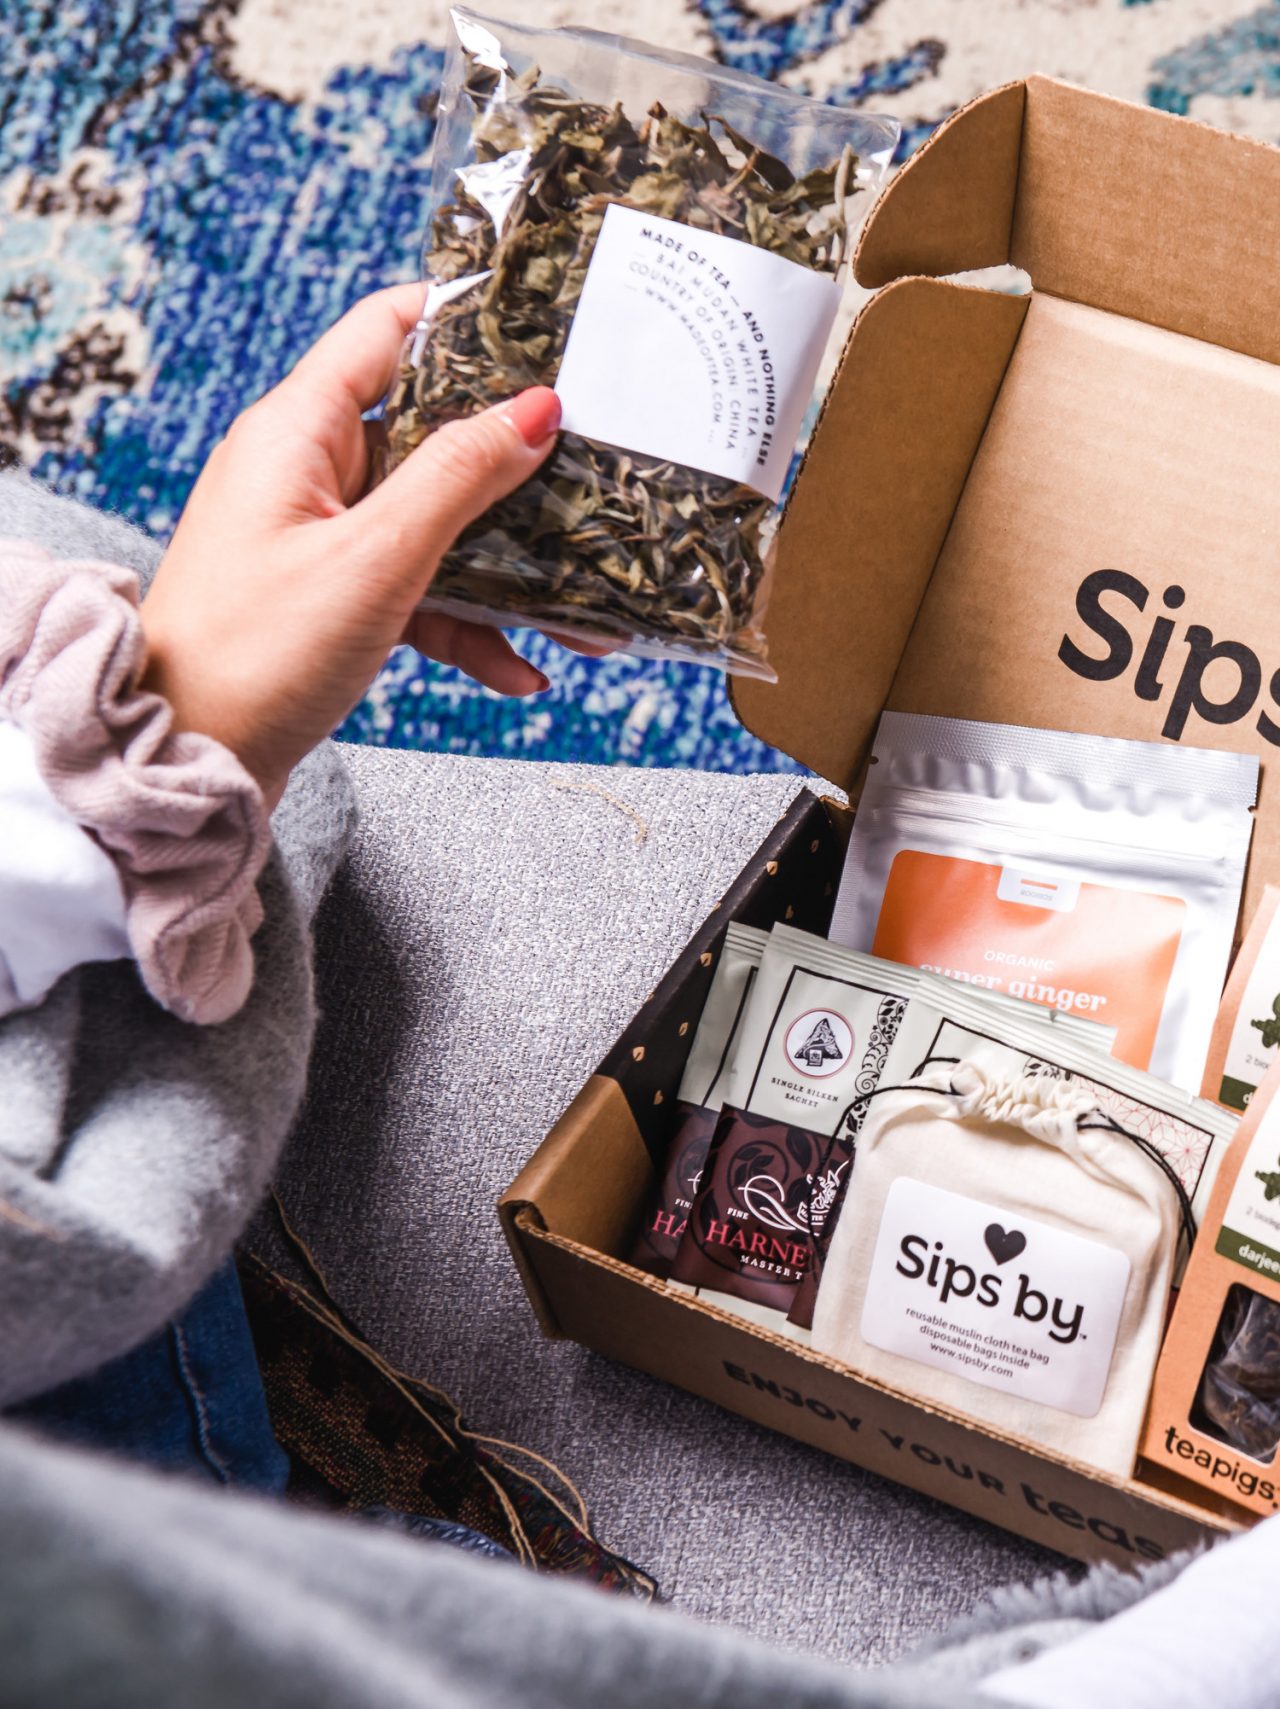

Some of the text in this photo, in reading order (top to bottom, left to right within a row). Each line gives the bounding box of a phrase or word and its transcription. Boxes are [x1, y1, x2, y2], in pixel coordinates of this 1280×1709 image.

[641, 228, 683, 252] MADE
[687, 250, 706, 266] OF
[709, 266, 730, 290] TEA
[692, 276, 738, 331] MUDAN
[742, 311, 764, 342] AND
[629, 261, 694, 302] COUNTRY
[696, 306, 714, 322] OF
[726, 399, 742, 449] CHINA
[736, 338, 760, 395] WHITE
[758, 349, 776, 425] NOTHING
[747, 407, 759, 436] TEA
[756, 432, 773, 466] ELSE
[984, 950, 1056, 972] ORGANIC
[1008, 976, 1107, 1012] ginger
[771, 1077, 839, 1102] SINGLE SILKEN
[785, 1093, 819, 1108] SACHET
[653, 1210, 688, 1239] HA
[727, 1207, 750, 1220] FINE
[705, 1220, 813, 1268] HARNE
[740, 1255, 791, 1277] MASTER
[896, 1234, 1085, 1345] Sips by
[906, 1307, 1051, 1365] reusable muslin cloth tea bag
[919, 1324, 1031, 1370] disposable bags inside
[930, 1341, 1014, 1378] www.sipsby.com
[721, 1360, 1166, 1561] ENJOY YOUR teas
